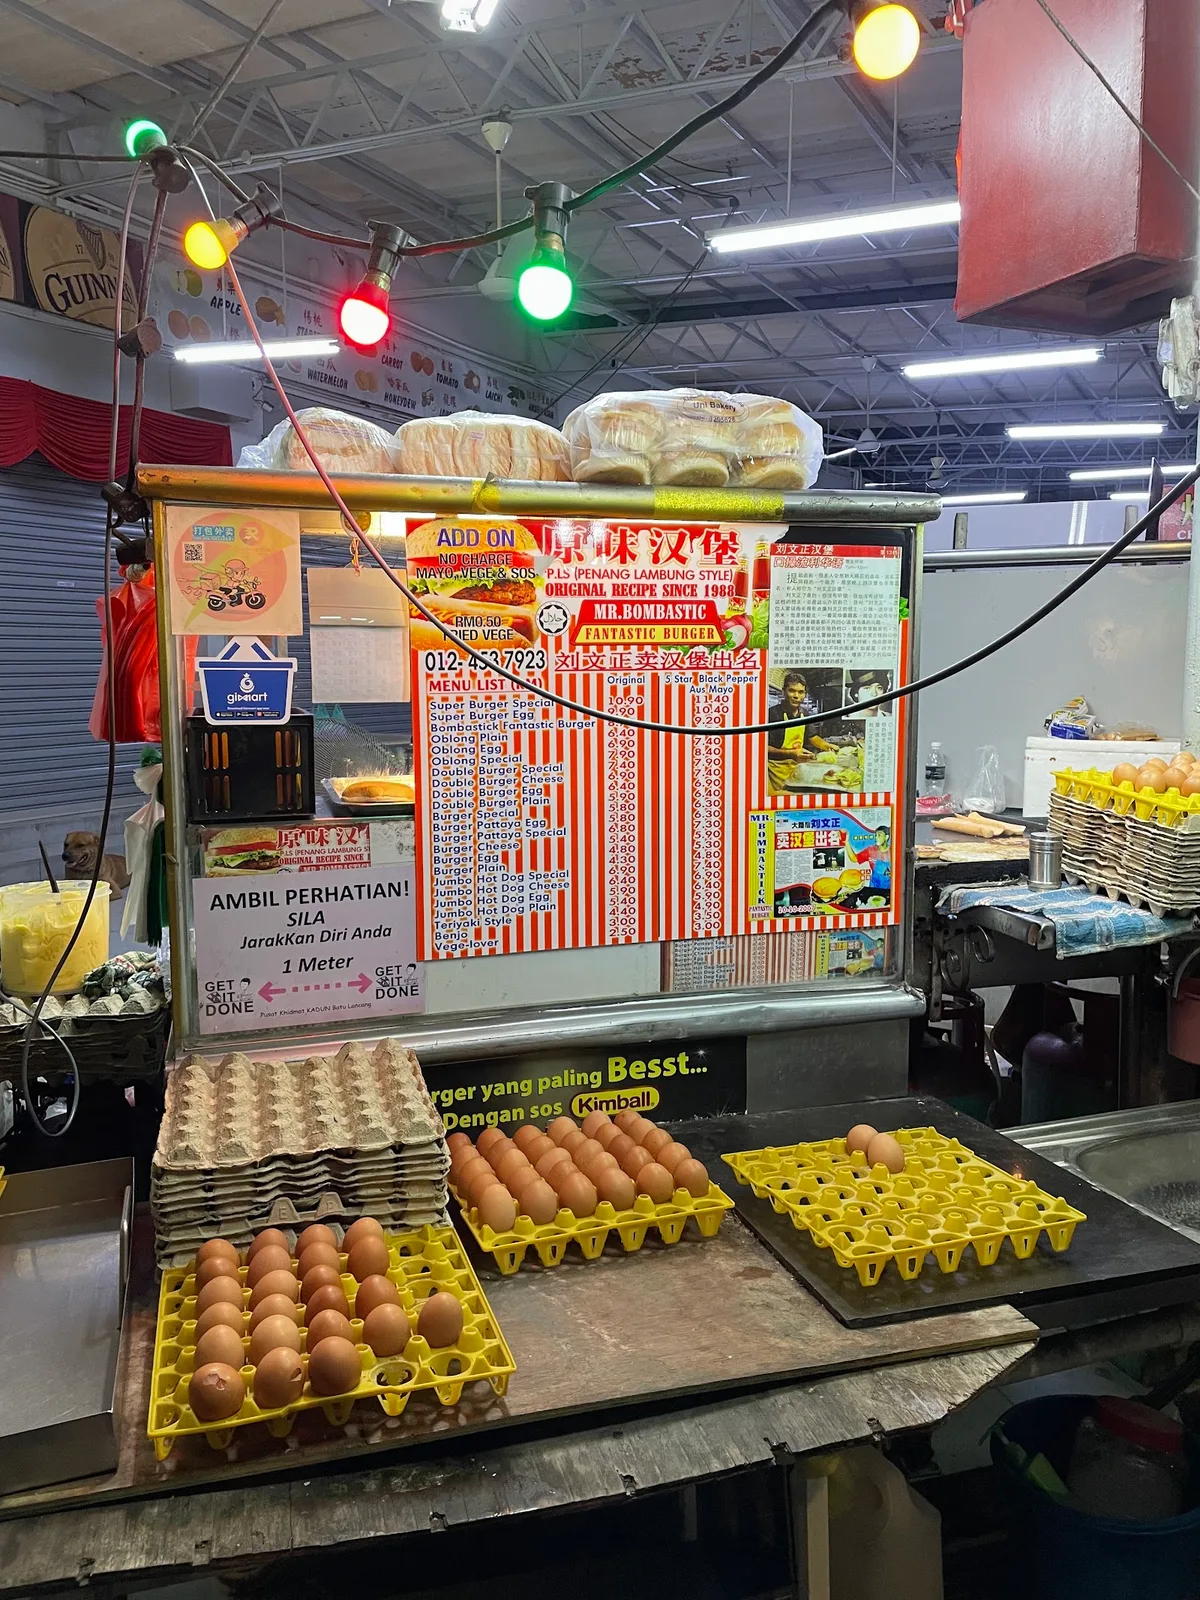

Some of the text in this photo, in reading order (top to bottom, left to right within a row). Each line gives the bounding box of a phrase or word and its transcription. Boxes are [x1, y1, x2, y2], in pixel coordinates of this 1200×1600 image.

[210, 295, 242, 316] APPLE
[381, 354, 403, 370] CARROT
[307, 368, 348, 390] WATERMELON
[436, 372, 459, 389] TOMATO
[384, 392, 417, 410] HONEYDEW
[710, 402, 736, 412] Bakery
[437, 528, 515, 547] ADD ON
[544, 527, 738, 566] 原味汉堡
[775, 543, 835, 556] 刘文正汉堡
[439, 553, 512, 565] NO CHARGE
[498, 567, 507, 578] &
[574, 568, 630, 581] (PENANG
[634, 569, 695, 580] LAMBUNG
[699, 569, 734, 582] STYLE)
[545, 583, 735, 598] ORIGINAL RECIPE SINCE 1988
[594, 604, 706, 620] MR.BOMBASTIC
[455, 616, 501, 628] RM0.50
[483, 629, 514, 640] VEGE
[585, 627, 715, 640] FANTASTIC BURGER
[425, 650, 545, 671] 012- 453 7923
[555, 651, 760, 671] 刘文正卖汉堡出名
[429, 680, 471, 692] MENU
[477, 679, 506, 691] LIST
[607, 675, 646, 685] Original
[674, 675, 693, 683] Star
[699, 674, 723, 683] Black
[726, 674, 758, 684] Pepper
[689, 685, 734, 695] Aus Mayo
[430, 698, 555, 711] Super Burger Special
[608, 696, 644, 705] 10.90
[695, 695, 730, 704] 11.40
[430, 709, 534, 722] Super Burger Egg
[607, 707, 635, 716] 9.90
[695, 705, 730, 714] 10.40
[430, 722, 499, 733] Bombastick
[503, 721, 554, 730] Fantastic
[558, 719, 596, 730] Burger
[694, 716, 721, 725] 9.20
[431, 733, 508, 744] Oblong Plain
[607, 728, 635, 737] 6.40
[431, 744, 502, 755] Oblong Egg
[608, 750, 635, 759] 7.90
[432, 754, 522, 766] Oblong Special
[432, 763, 563, 777] Double Burger Special
[432, 775, 564, 788] Double Burger Cheese
[609, 793, 635, 802] 5.90
[432, 808, 519, 822] Burger Special
[433, 818, 546, 833] Burger Pattaya Egg
[694, 820, 721, 828] 7.30
[276, 826, 370, 849] 原味汉
[776, 830, 841, 849] 卖汉堡出名
[328, 846, 361, 854] LAMBUNG
[433, 841, 520, 854] Burger Cheese
[609, 845, 635, 854] 4.80
[279, 853, 364, 865] ORIGINAL RECIPE SINCE
[757, 823, 767, 904] BOMBASTICK
[434, 870, 569, 887] Jumbo Hot Dog Special
[209, 880, 410, 911] AMBIL PERHATIAN!
[434, 902, 556, 919] Jumbo Hot Dog Plain
[286, 910, 326, 927] SILA
[434, 916, 512, 930] Teriyaki Style
[609, 928, 636, 937] 2.50
[694, 922, 721, 931] 3.00
[240, 925, 392, 950] JarakKan Diri Anda
[434, 931, 468, 941] Benjo
[434, 940, 499, 952] Vege-lover
[282, 955, 354, 974] 1 Meter
[375, 965, 402, 976] GET
[204, 979, 235, 992] GET
[390, 976, 402, 987] IT
[222, 991, 235, 1003] IT
[375, 985, 420, 1000] DONE
[205, 1000, 254, 1016] DONE
[279, 1008, 305, 1016] Khidmat
[306, 1005, 331, 1014] KADUN
[431, 1051, 708, 1107] rger yang paling Besst...
[443, 1091, 650, 1131] Dengan sos Kimball
